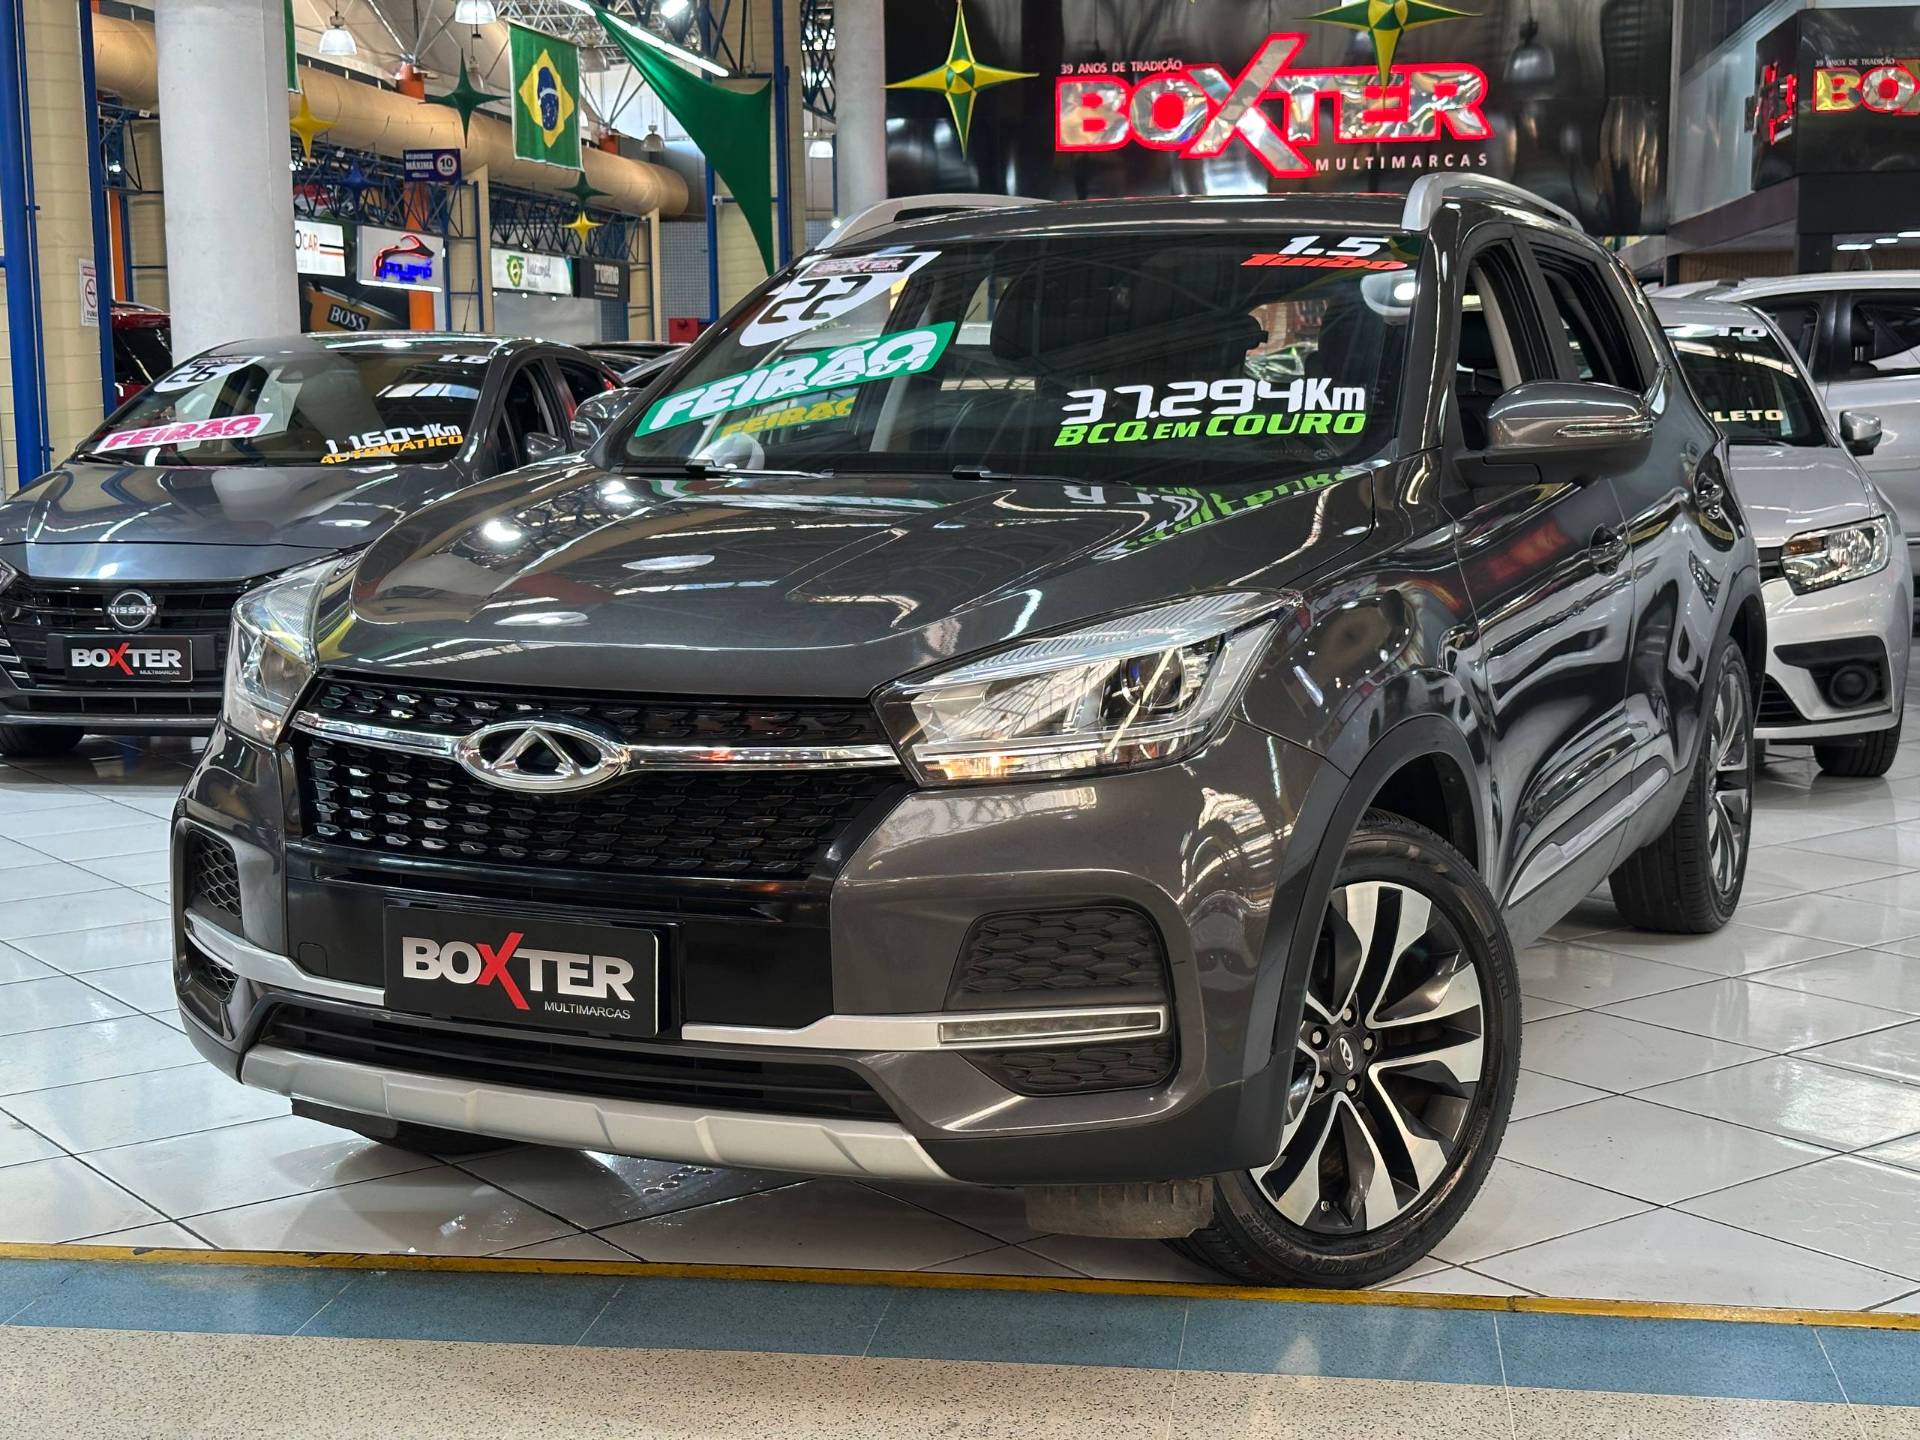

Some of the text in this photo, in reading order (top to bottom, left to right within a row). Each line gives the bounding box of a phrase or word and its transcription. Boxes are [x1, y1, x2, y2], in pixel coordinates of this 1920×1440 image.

[1060, 58, 1183, 74] 39 ANOS DE TRADIÇÃO
[1056, 33, 1494, 178] BOXTER
[440, 158, 453, 168] 10
[1315, 152, 1488, 171] MULTIMARCAS
[1278, 238, 1390, 257] 1.5
[757, 274, 873, 324] 22
[331, 306, 366, 331] BOSS
[438, 353, 491, 365] 1.6
[164, 363, 219, 384] 26
[649, 331, 938, 430] FEIRÃO
[1060, 377, 1366, 425] 37.294Km
[1152, 421, 1201, 440] EM
[1205, 413, 1366, 437] COURO
[1708, 409, 1784, 422] LETO
[104, 416, 262, 448] FEIRÃO
[107, 606, 157, 614] NISSAN
[71, 642, 182, 676] BOXTER
[402, 931, 635, 1010] BOXTER
[544, 1001, 631, 1019] MULTIMARCAS
